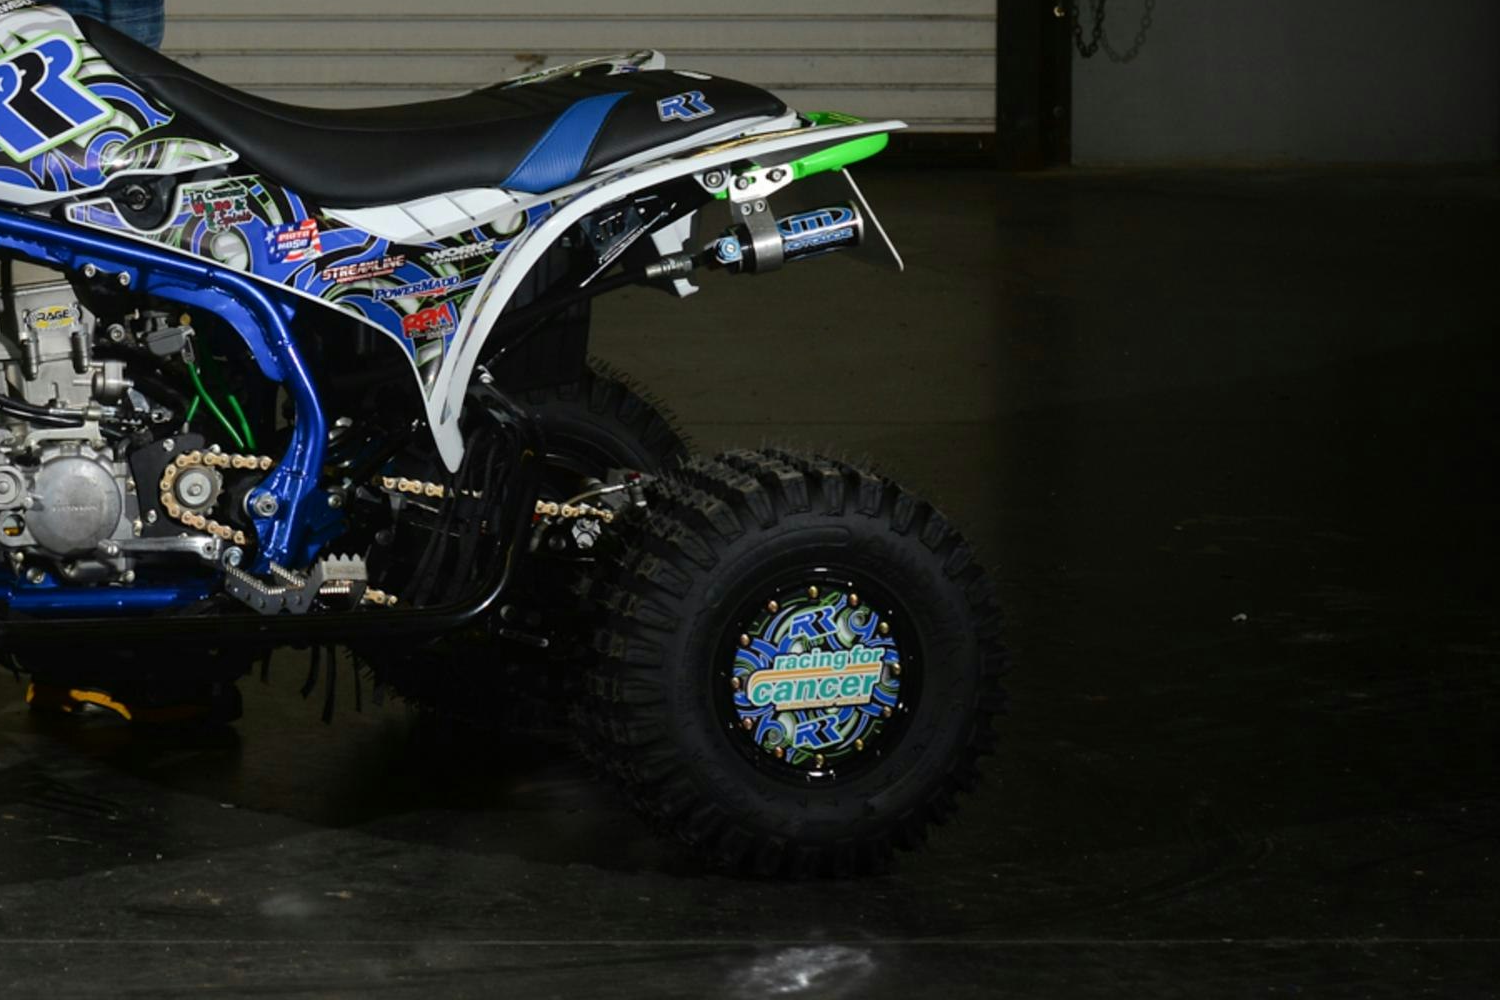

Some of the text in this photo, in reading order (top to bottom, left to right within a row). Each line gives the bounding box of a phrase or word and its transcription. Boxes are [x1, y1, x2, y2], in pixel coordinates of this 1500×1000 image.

[425, 238, 496, 260] WORKS
[322, 255, 405, 281] STREAMLINE
[402, 303, 453, 337] RPM
[774, 645, 884, 671] racing for
[751, 672, 880, 706] cancer
